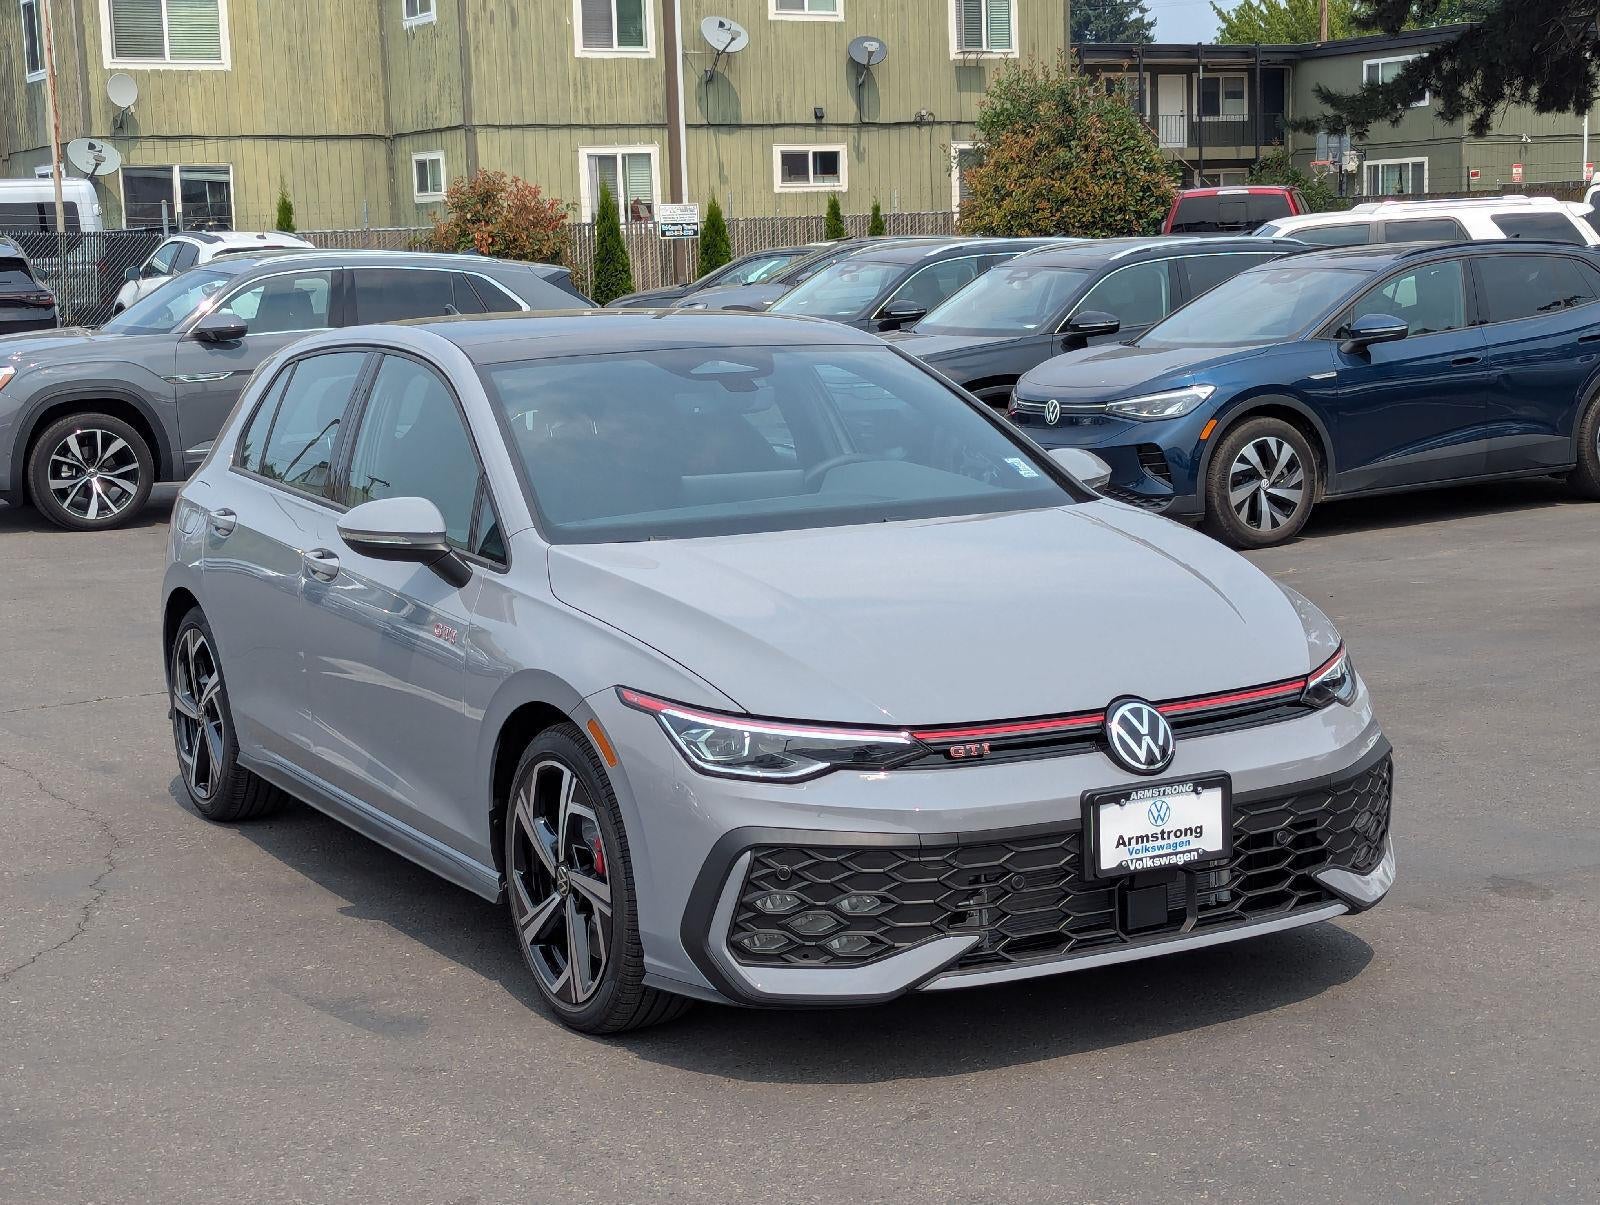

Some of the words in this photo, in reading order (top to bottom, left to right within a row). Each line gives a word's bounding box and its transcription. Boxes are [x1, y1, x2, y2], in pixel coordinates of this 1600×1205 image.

[1111, 702, 1174, 770] VW
[949, 742, 991, 758] GTI
[1129, 783, 1194, 801] ARMSTRONG
[1148, 800, 1171, 827] VW
[1114, 825, 1204, 849] Armstrong
[1127, 838, 1191, 856] Volkswagen
[1127, 850, 1198, 871] Volkswagen
